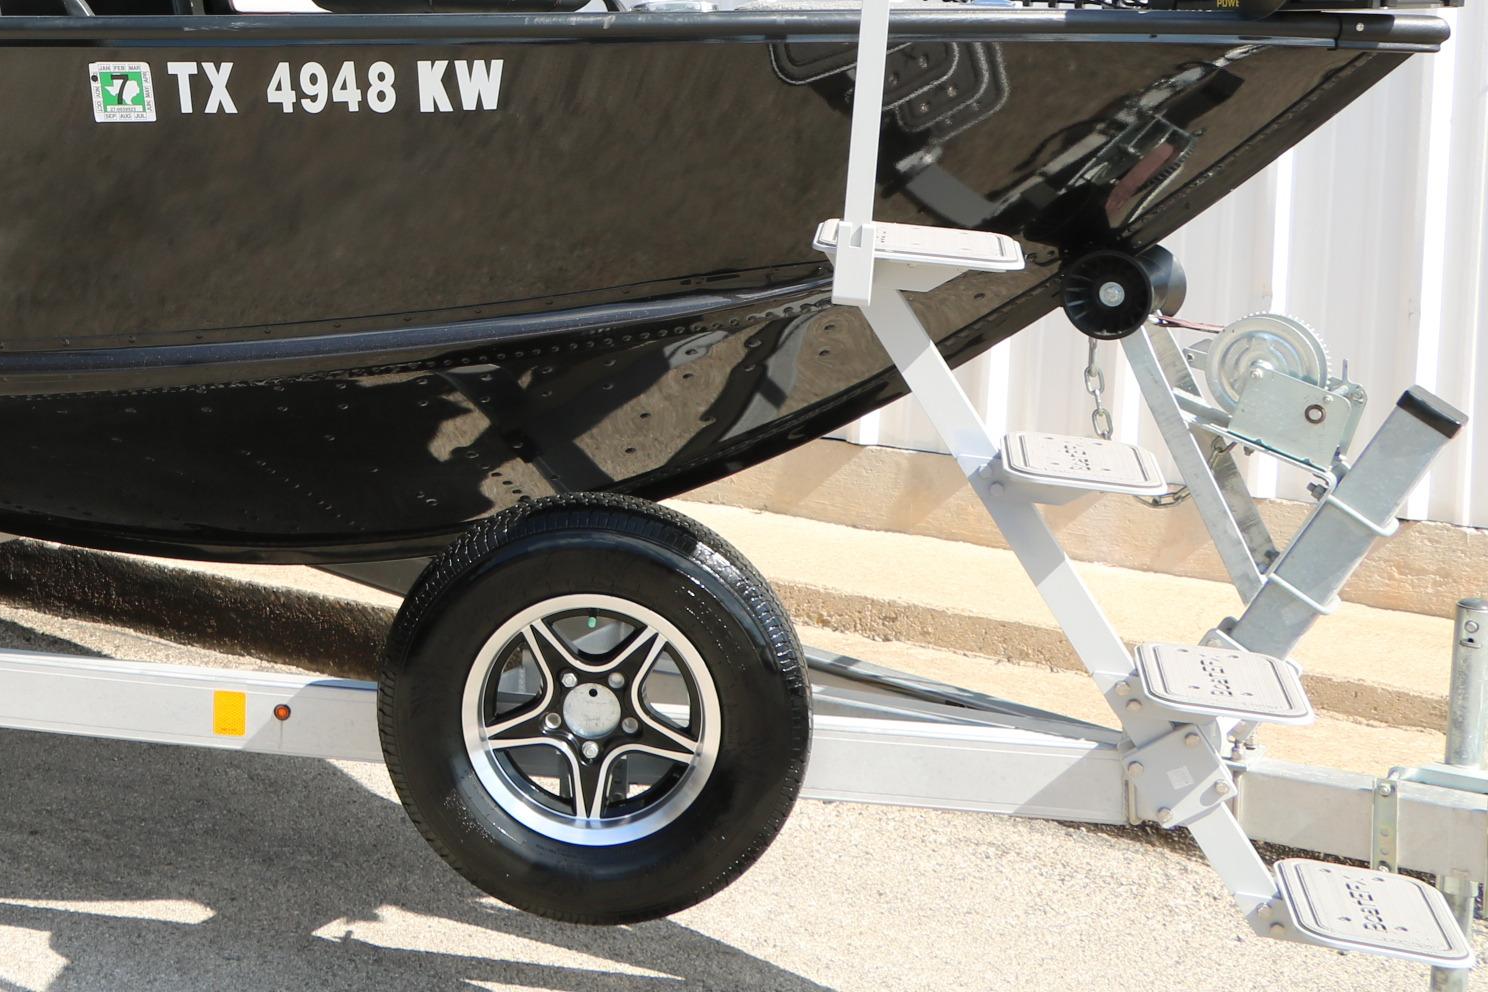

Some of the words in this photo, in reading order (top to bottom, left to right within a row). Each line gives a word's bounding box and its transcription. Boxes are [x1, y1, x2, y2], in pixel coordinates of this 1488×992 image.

[111, 74, 129, 105] 7
[167, 61, 238, 114] TX
[266, 60, 397, 114] 4948
[417, 59, 504, 113] KW
